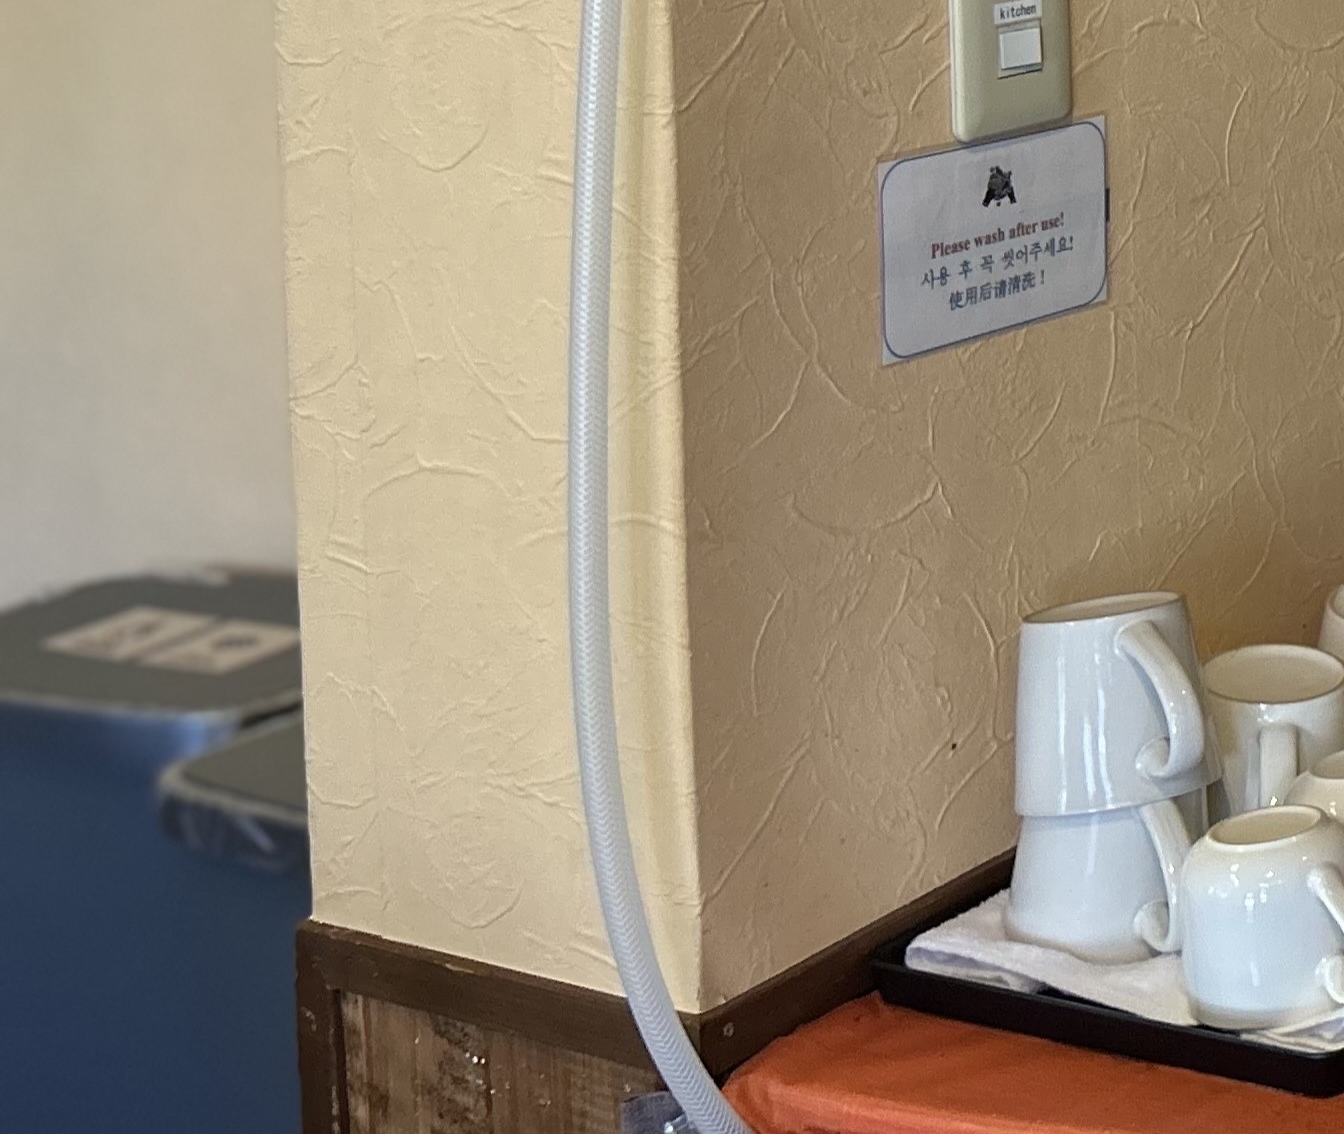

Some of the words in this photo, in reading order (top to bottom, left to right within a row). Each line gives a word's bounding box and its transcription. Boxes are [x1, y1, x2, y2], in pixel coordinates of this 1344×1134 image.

[1000, 4, 1037, 20] kitchen
[931, 236, 970, 259] Please
[974, 228, 1005, 247] wash
[1009, 220, 1039, 239] after
[1041, 212, 1065, 231] use!
[921, 267, 951, 290] 사용
[958, 260, 973, 280] 후
[980, 256, 994, 274] 꼭
[1001, 236, 1074, 270] 씻어주세요!
